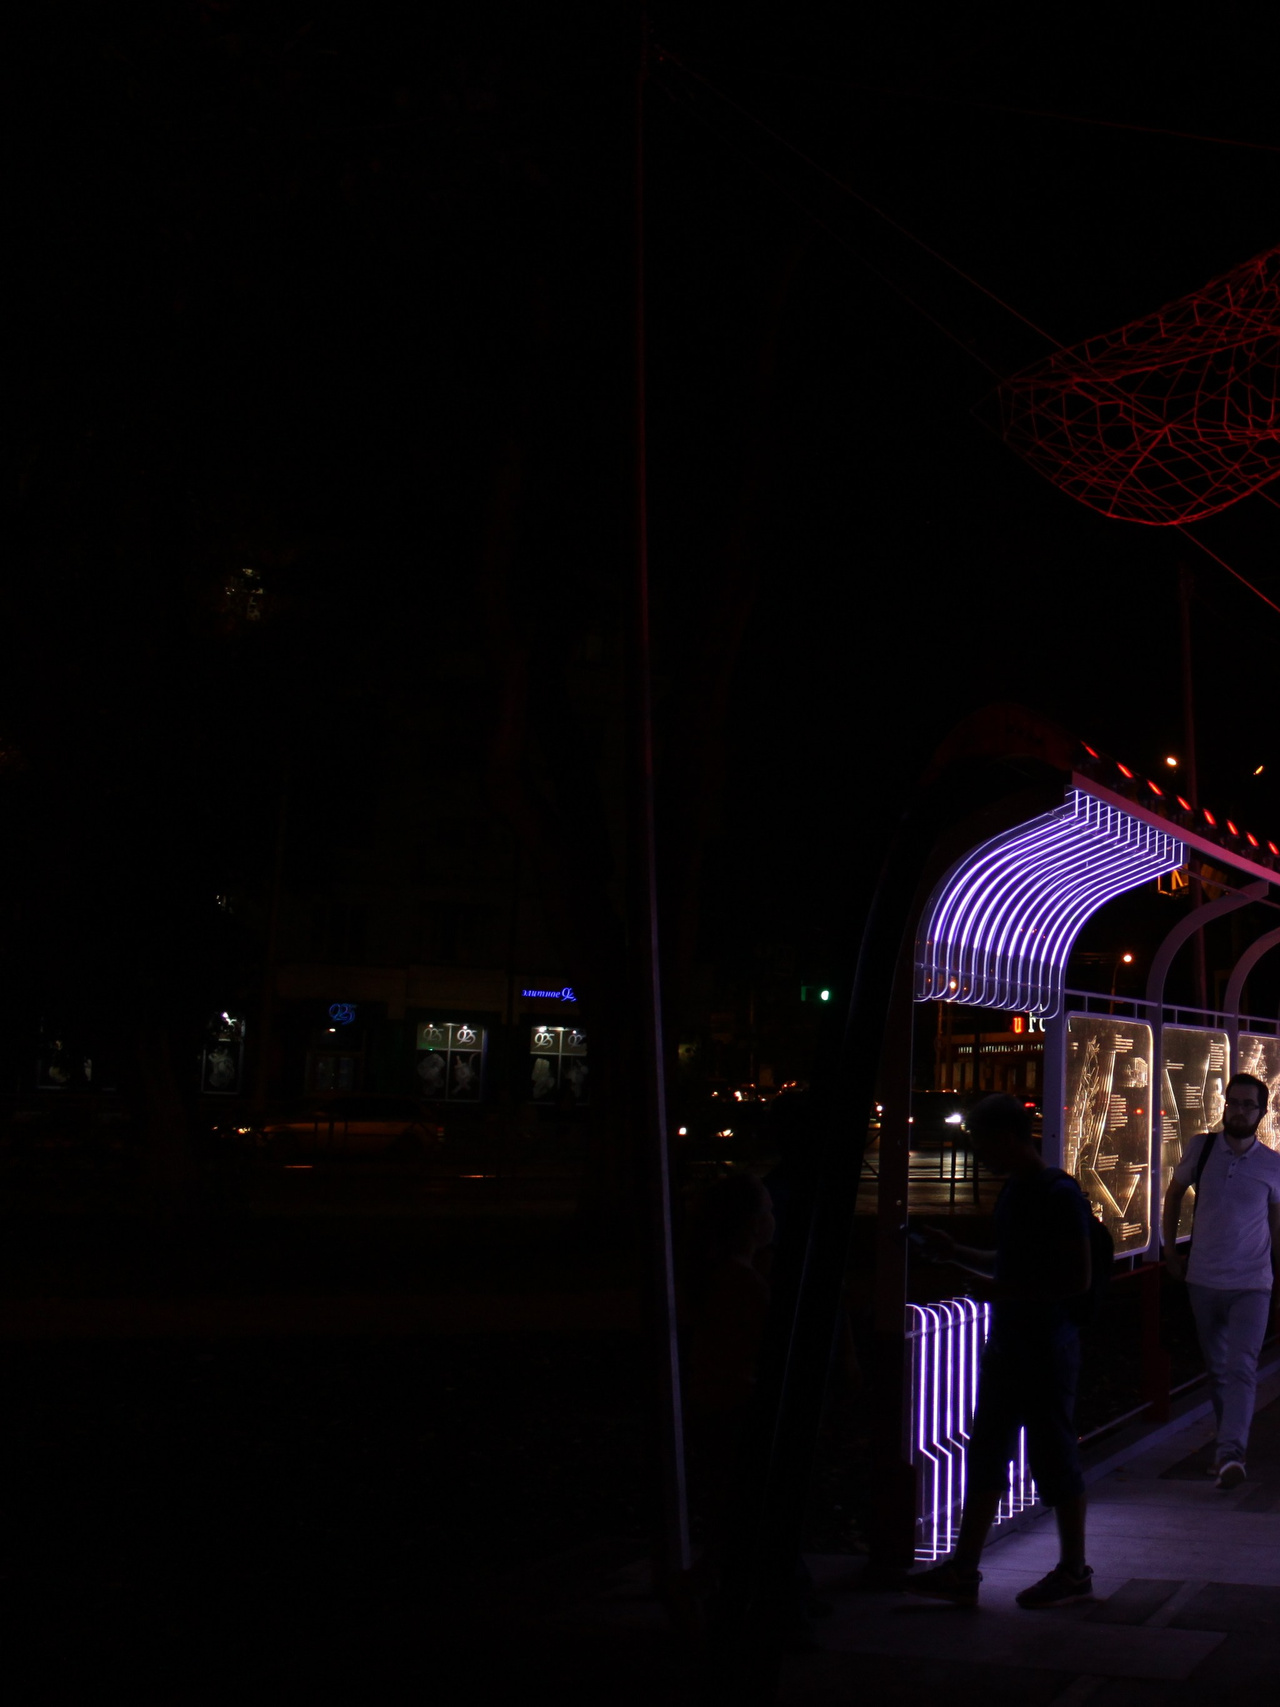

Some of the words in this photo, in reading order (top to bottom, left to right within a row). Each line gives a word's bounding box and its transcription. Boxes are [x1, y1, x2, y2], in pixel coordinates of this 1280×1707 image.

[328, 1002, 359, 1026] 925
[457, 1028, 478, 1045] 925
[534, 1032, 555, 1048] 925
